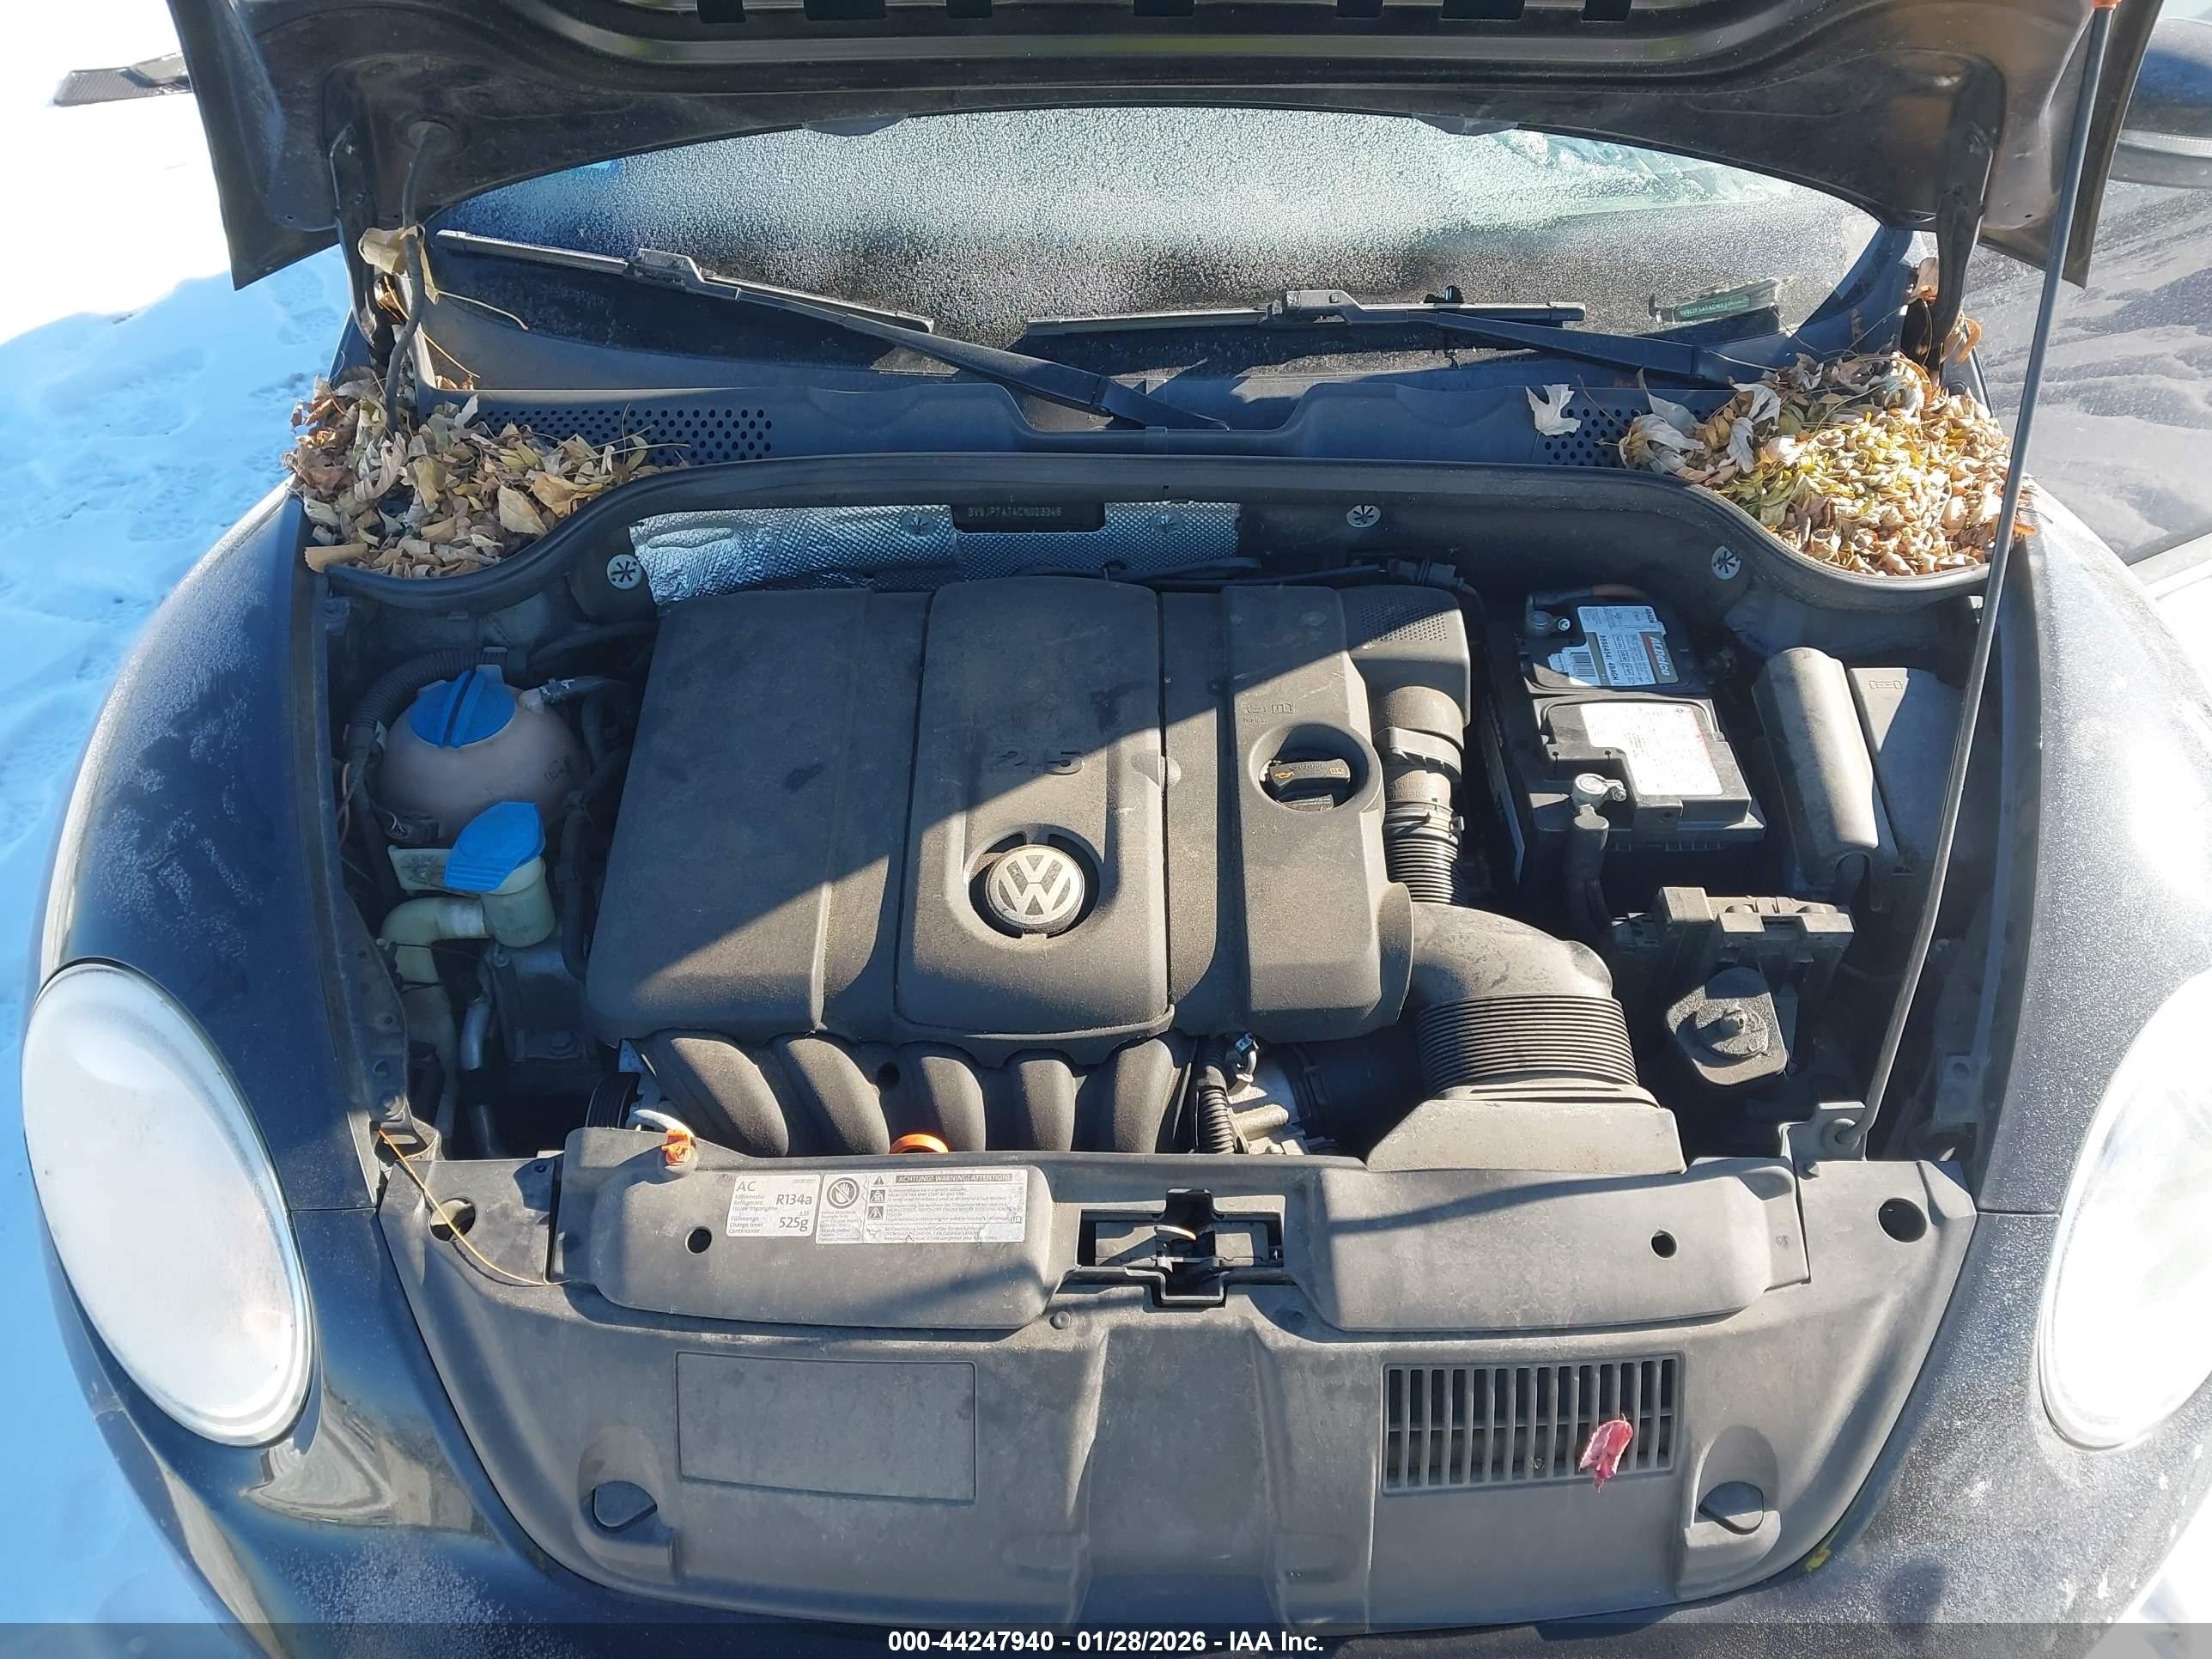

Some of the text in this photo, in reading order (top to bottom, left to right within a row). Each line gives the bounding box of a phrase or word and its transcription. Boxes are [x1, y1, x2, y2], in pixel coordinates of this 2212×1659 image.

[1649, 636, 1670, 676] ACDelco
[993, 850, 1077, 920] VW
[935, 1174, 970, 1182] WARNING!
[736, 1181, 757, 1192] AC
[775, 1194, 812, 1206] R134a
[778, 1217, 809, 1232] 525g
